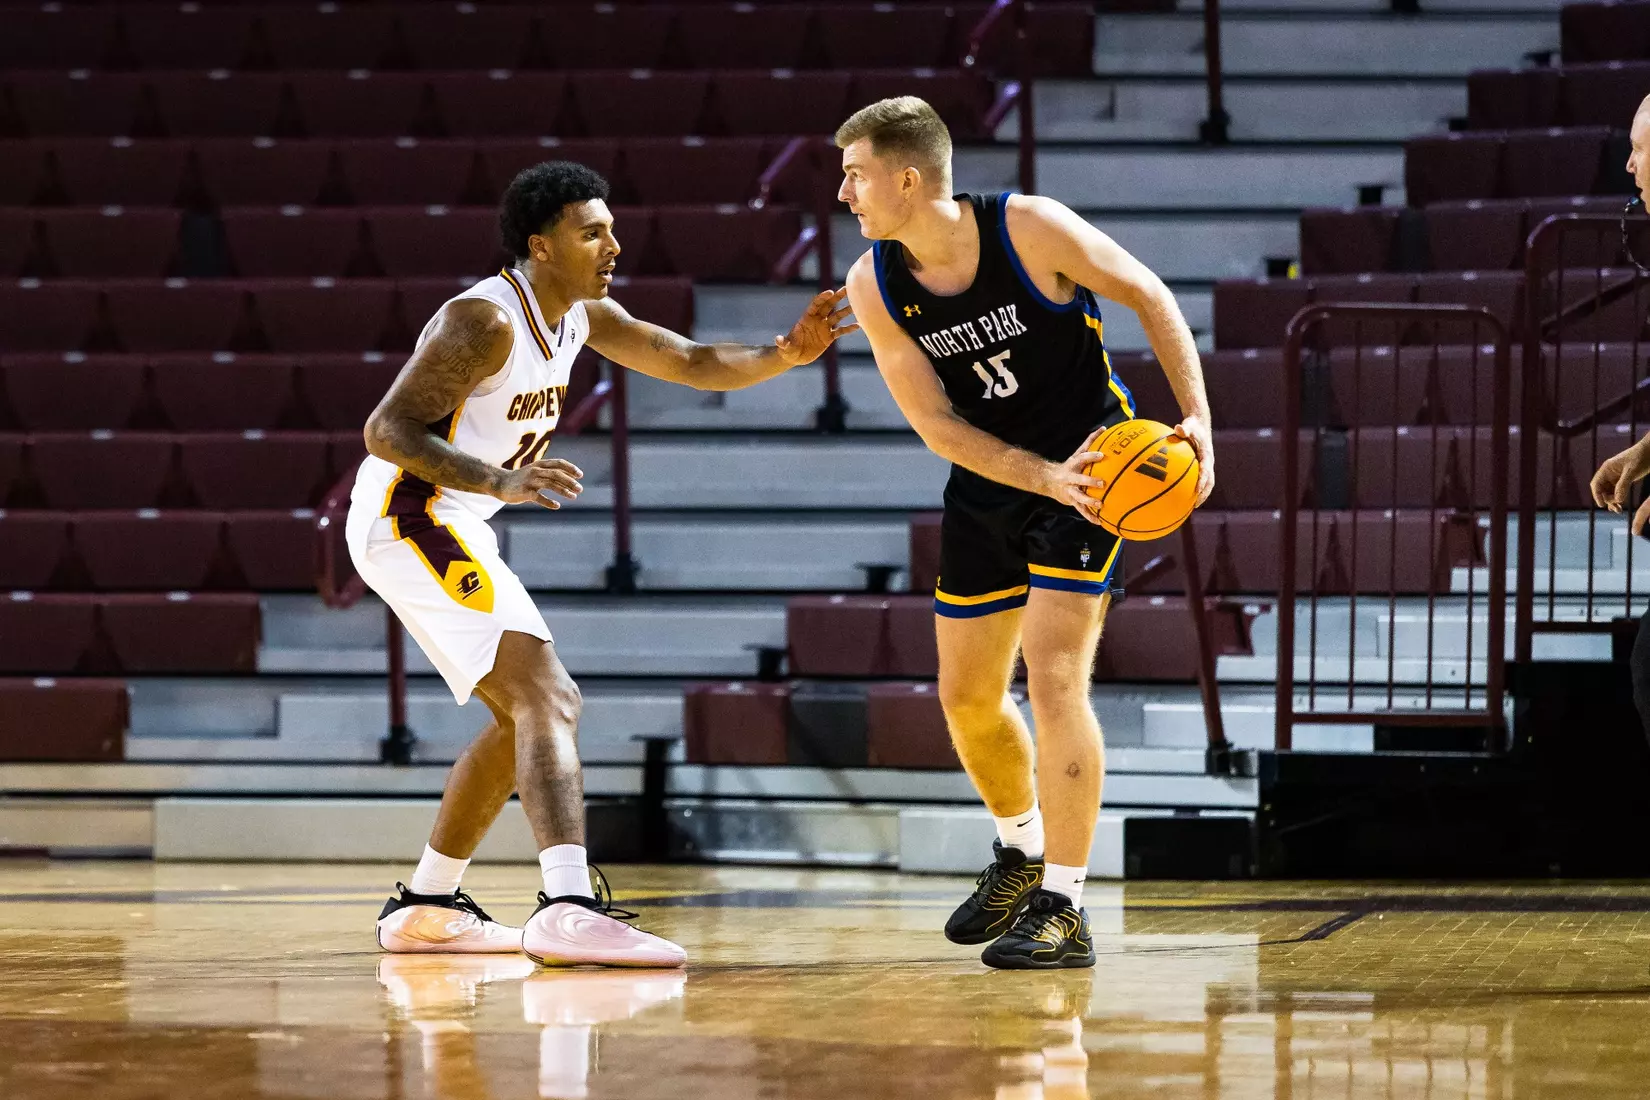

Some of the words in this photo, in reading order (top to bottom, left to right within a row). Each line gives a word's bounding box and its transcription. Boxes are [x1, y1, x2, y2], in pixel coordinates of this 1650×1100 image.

[919, 321, 985, 358] NORTH
[978, 303, 1028, 343] PARK
[972, 349, 1019, 400] 15
